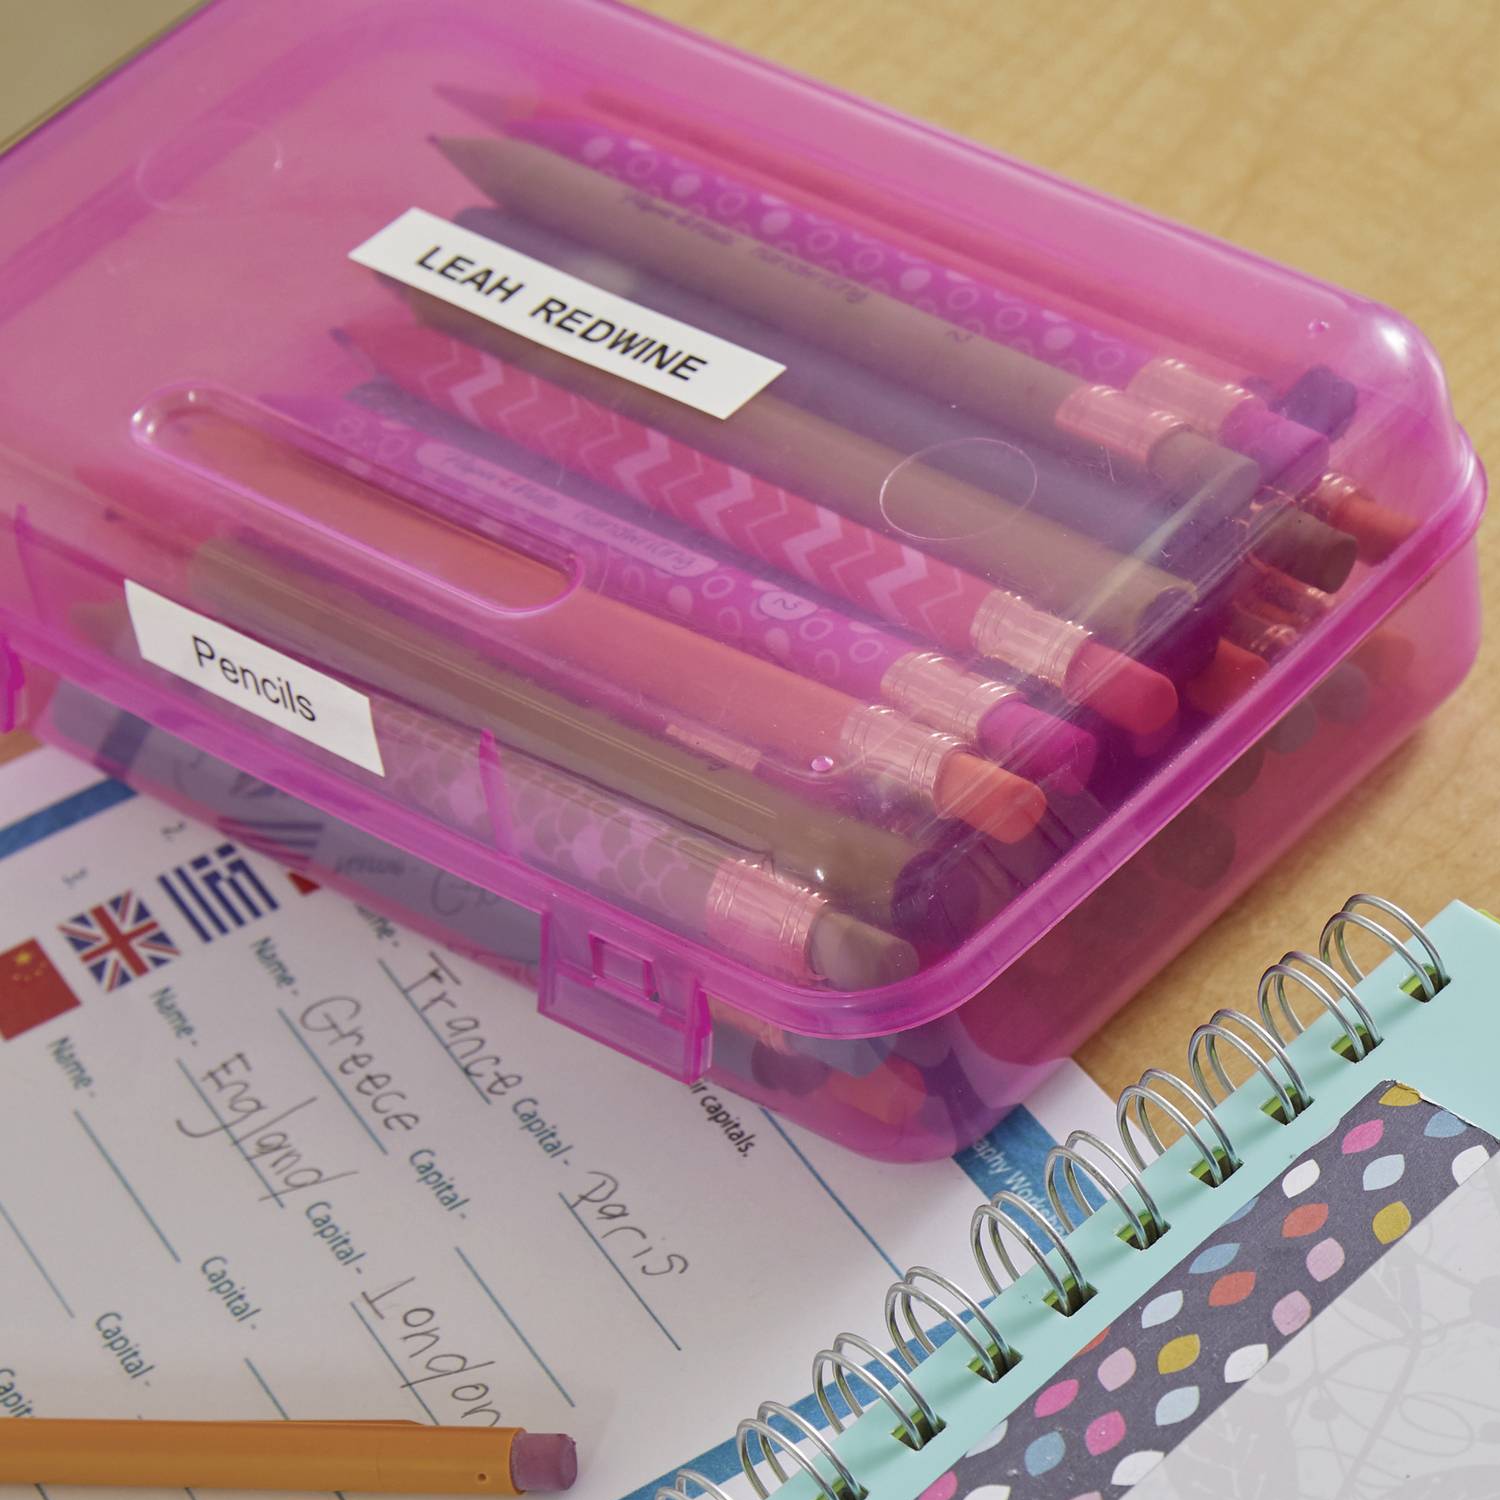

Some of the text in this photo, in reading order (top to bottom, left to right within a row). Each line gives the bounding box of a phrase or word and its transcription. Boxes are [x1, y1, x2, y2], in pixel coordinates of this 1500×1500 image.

[415, 245, 709, 382] LEAH REDWINE
[191, 635, 316, 722] Pencils
[401, 950, 523, 1096] France
[300, 995, 420, 1132] Greece
[176, 1052, 359, 1202] England
[512, 1097, 574, 1159] Capital
[699, 1095, 756, 1158] capitals.
[408, 1148, 470, 1212] Capital
[305, 1200, 366, 1266] Capital
[570, 1170, 689, 1277] Paris
[200, 1255, 262, 1322] Capital
[95, 1311, 155, 1379] Capital
